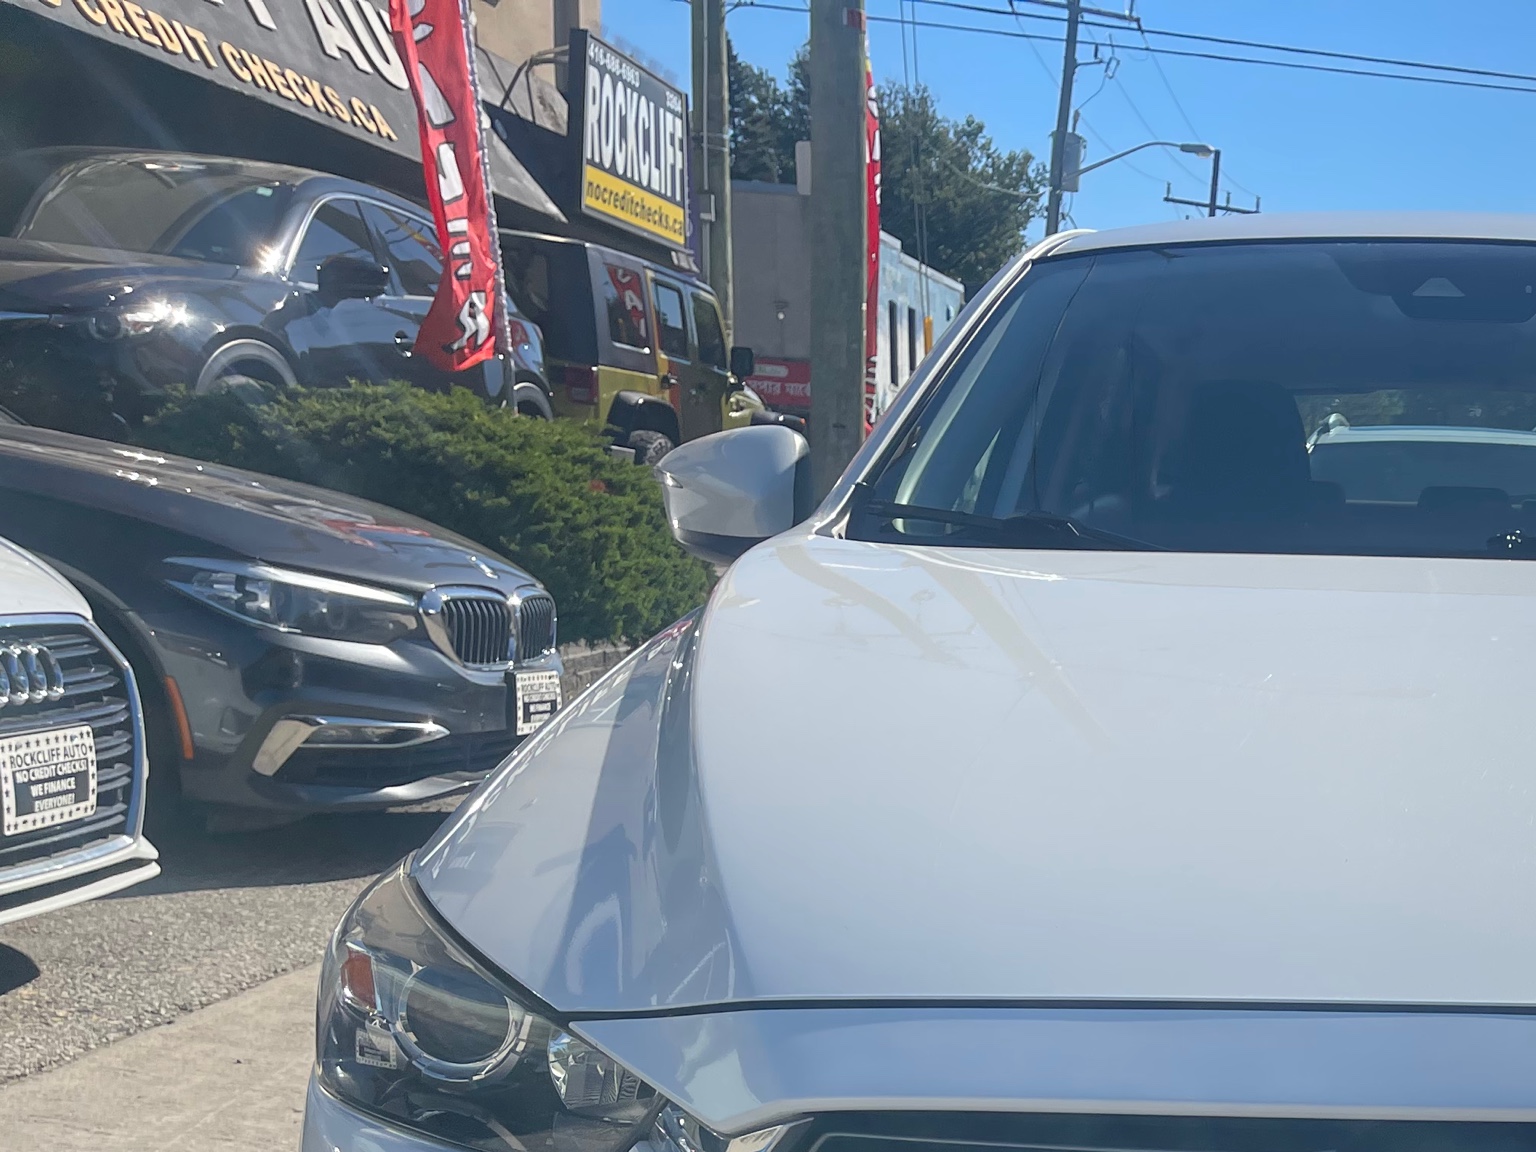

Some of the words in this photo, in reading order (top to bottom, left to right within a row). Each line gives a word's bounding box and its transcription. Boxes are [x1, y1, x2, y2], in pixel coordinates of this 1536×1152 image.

[303, 0, 408, 90] AU
[219, 41, 398, 141] CHECKS.CA
[586, 65, 683, 202] ROCKCLIFF
[586, 181, 684, 236] nocreditchecks.ca
[9, 747, 61, 769] ROCKCLIFF
[63, 743, 88, 758] AUTO
[15, 771, 29, 784] NO
[29, 765, 57, 781] CREDIT
[56, 759, 88, 776] CHECKS!
[30, 784, 44, 797] WE
[44, 777, 76, 796] FINANCE
[34, 793, 76, 812] EVERYONE!
